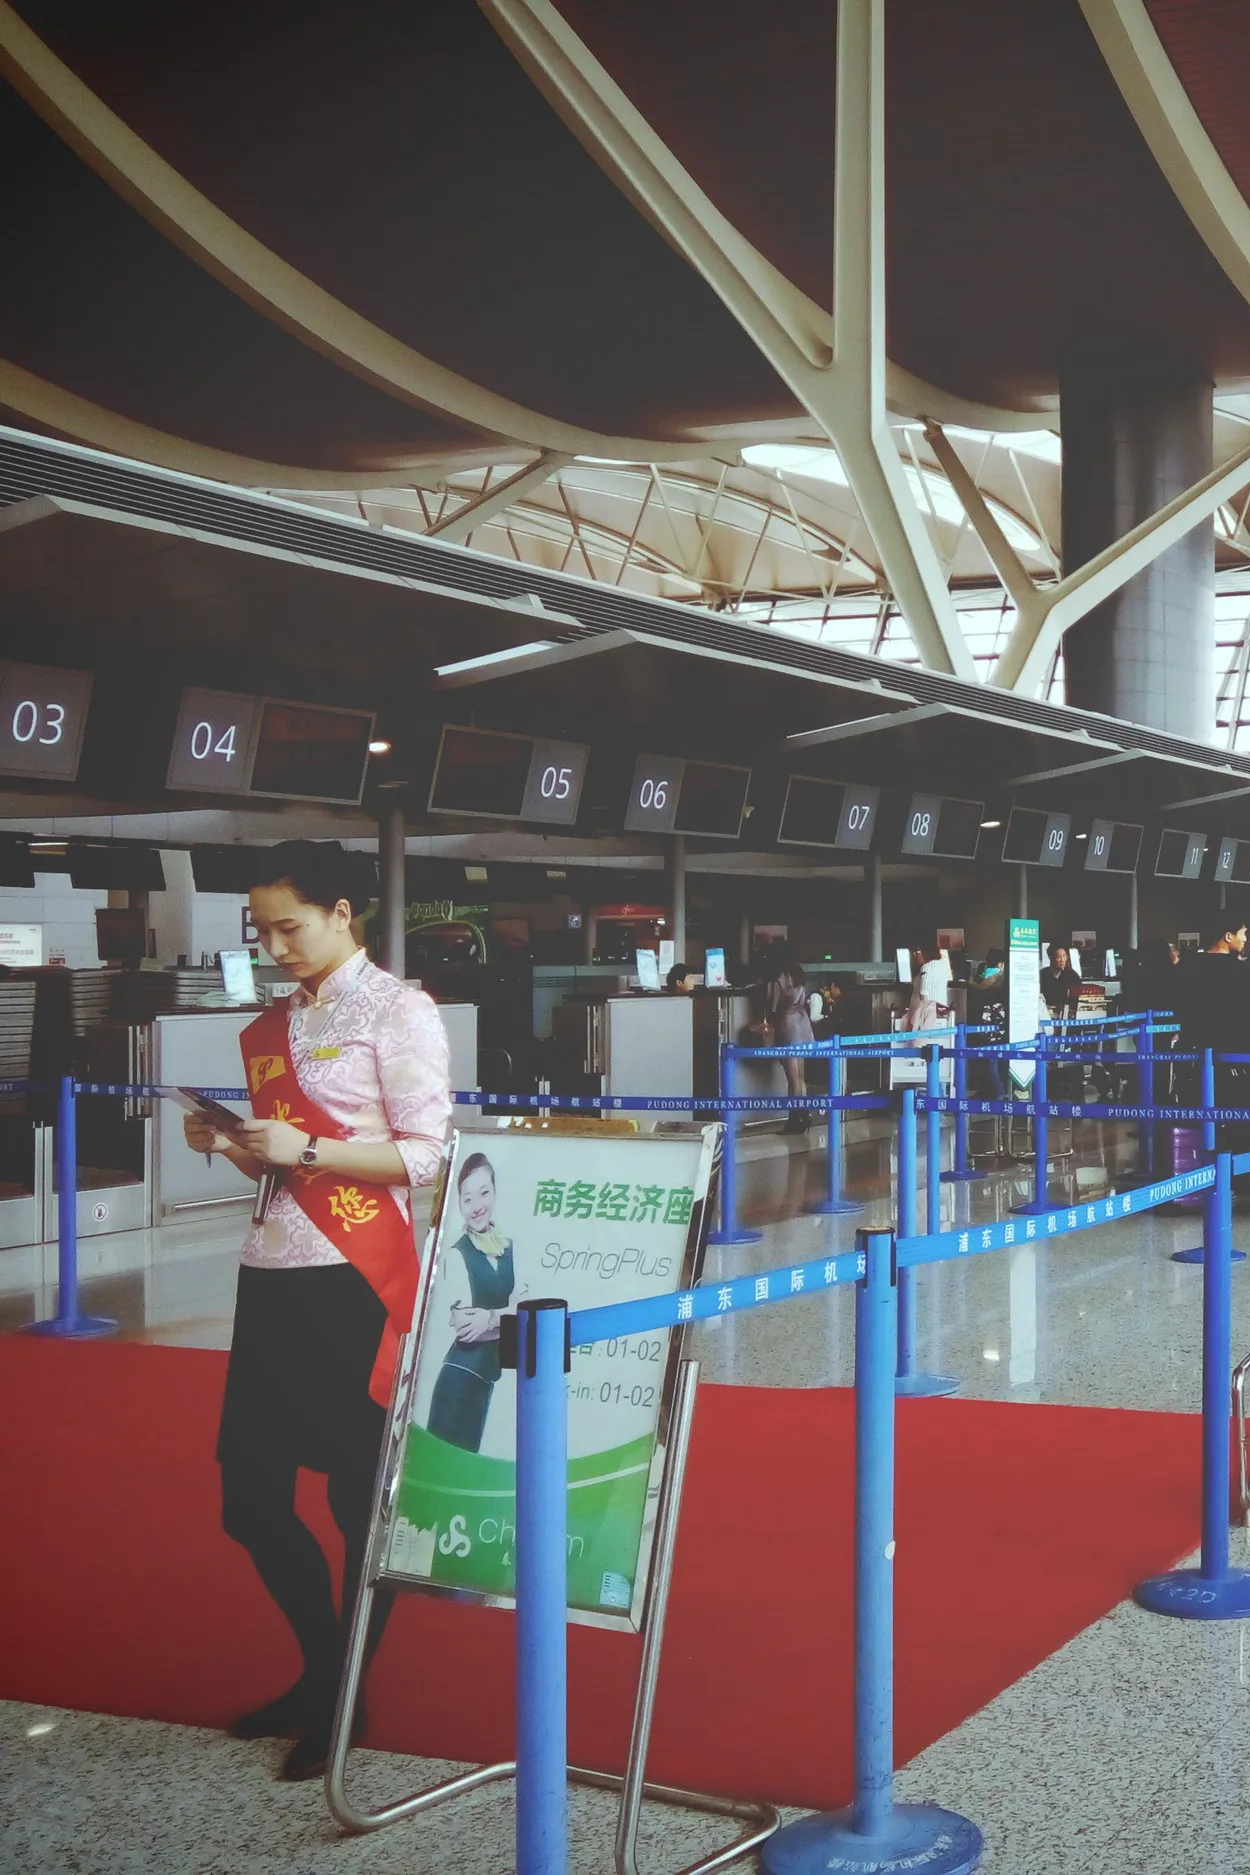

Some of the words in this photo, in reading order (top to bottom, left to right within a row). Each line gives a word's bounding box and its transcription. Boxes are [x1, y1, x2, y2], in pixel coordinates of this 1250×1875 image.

[12, 700, 65, 745] 03
[190, 721, 236, 762] 04
[540, 766, 572, 799] 05
[639, 779, 669, 809] 06
[848, 805, 870, 831] 07
[911, 813, 931, 836] 08
[1048, 829, 1064, 850] 09
[1094, 836, 1105, 856] 10
[1191, 847, 1199, 865] 11
[1222, 851, 1231, 869] 12
[203, 1090, 239, 1099] PUDONG
[647, 1101, 690, 1109] PUDONG
[694, 1100, 782, 1110] INTERNATIONAL
[786, 1098, 834, 1108] AIRPORT
[1108, 1108, 1154, 1118] PUDONG
[1150, 1177, 1184, 1201] PUDONG
[533, 1179, 695, 1226] 商务经济座
[958, 1195, 1131, 1253] 浦东国际机场航站楼
[540, 1242, 672, 1280] SpringPlus
[600, 1382, 655, 1408] 01-02
